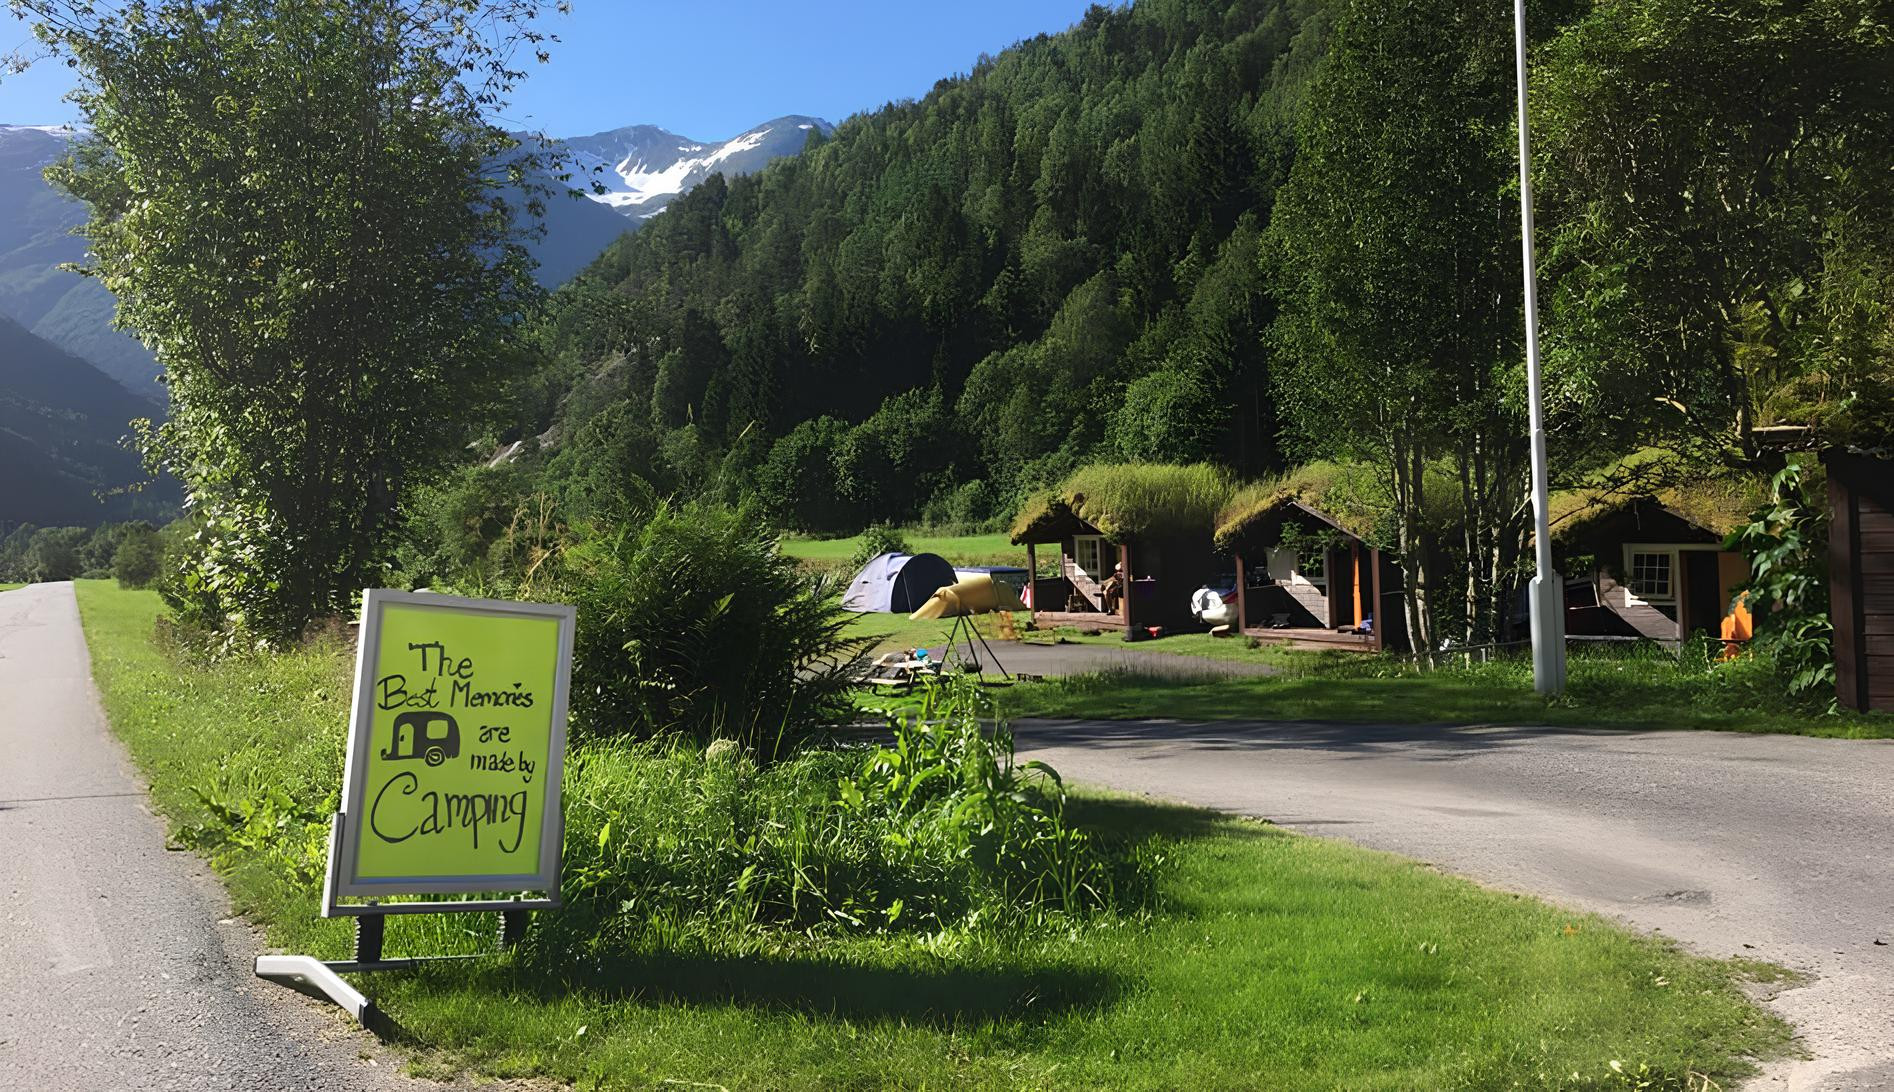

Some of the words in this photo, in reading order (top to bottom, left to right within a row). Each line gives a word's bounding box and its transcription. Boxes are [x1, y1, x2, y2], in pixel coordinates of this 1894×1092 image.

[408, 641, 474, 679] The
[377, 674, 440, 710] Best
[479, 725, 511, 743] are
[470, 751, 516, 773] made
[518, 751, 535, 783] by
[371, 771, 527, 853] Camping
